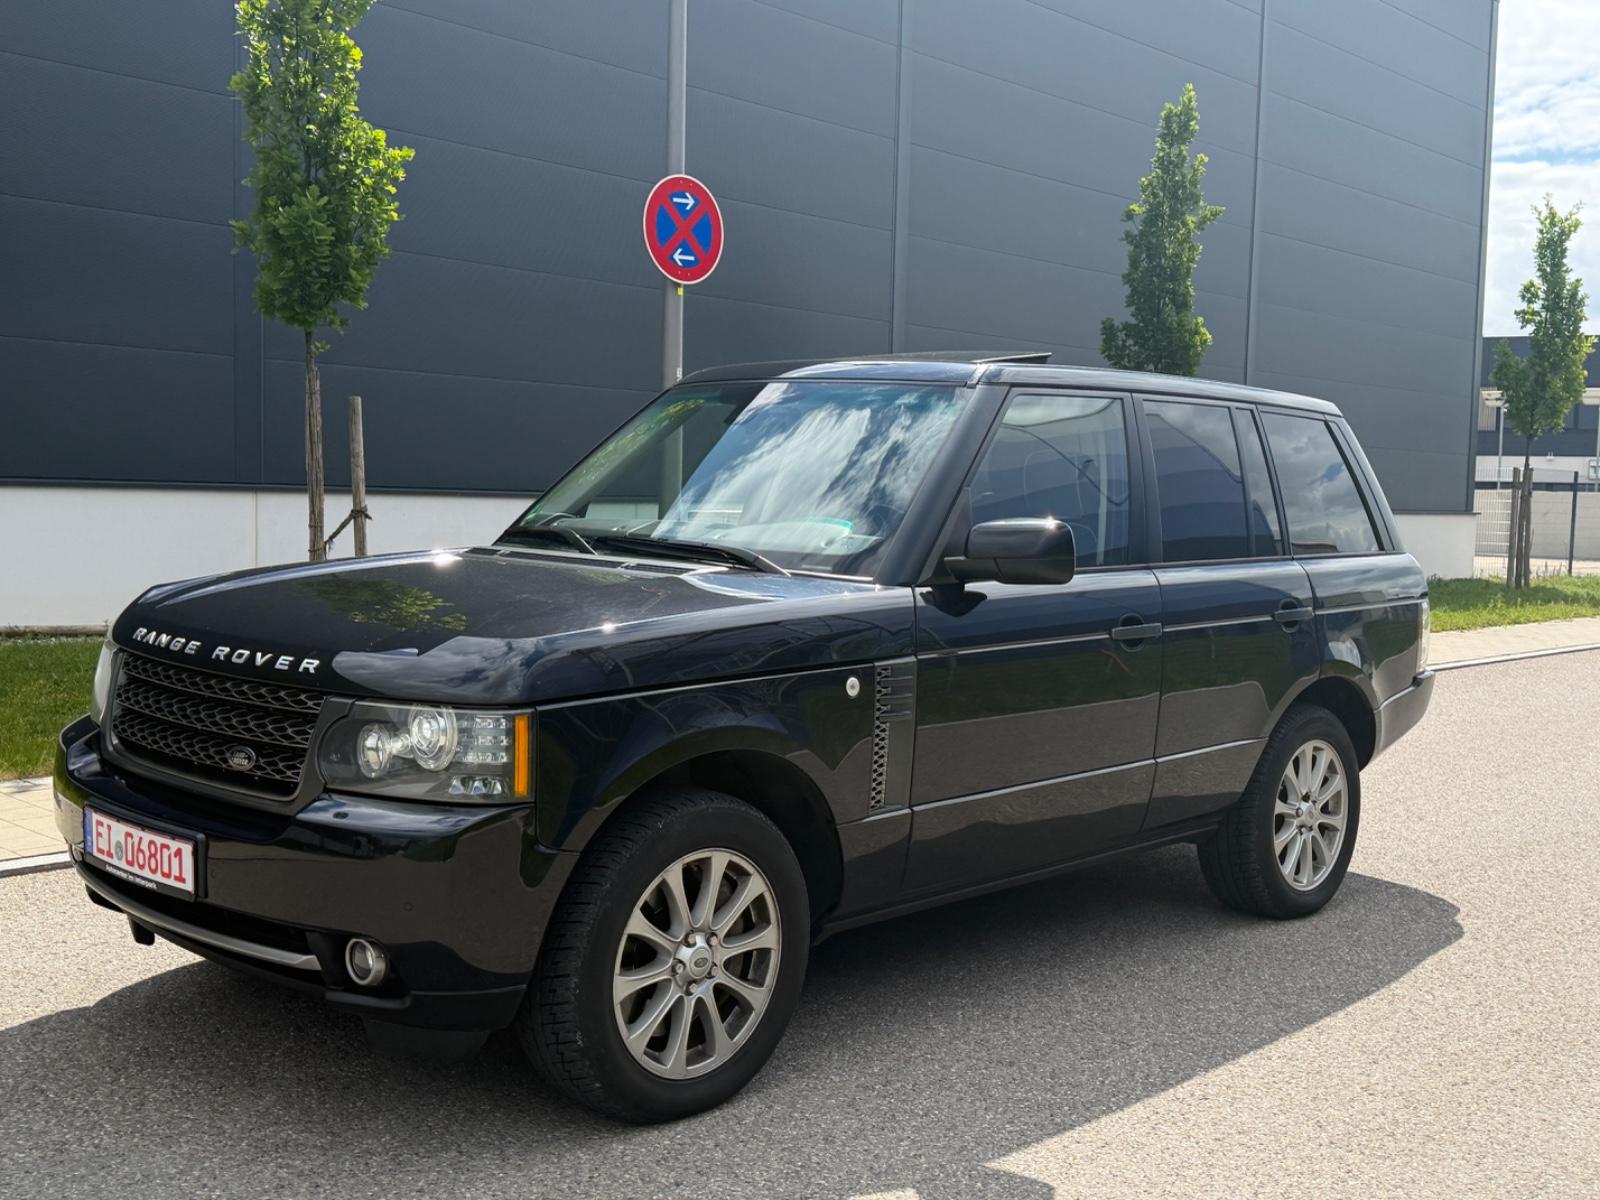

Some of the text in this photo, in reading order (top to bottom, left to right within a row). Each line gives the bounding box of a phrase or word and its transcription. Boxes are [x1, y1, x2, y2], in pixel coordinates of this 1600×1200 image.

[133, 627, 320, 673] RANGE ROVER
[96, 820, 186, 884] EI 06801
